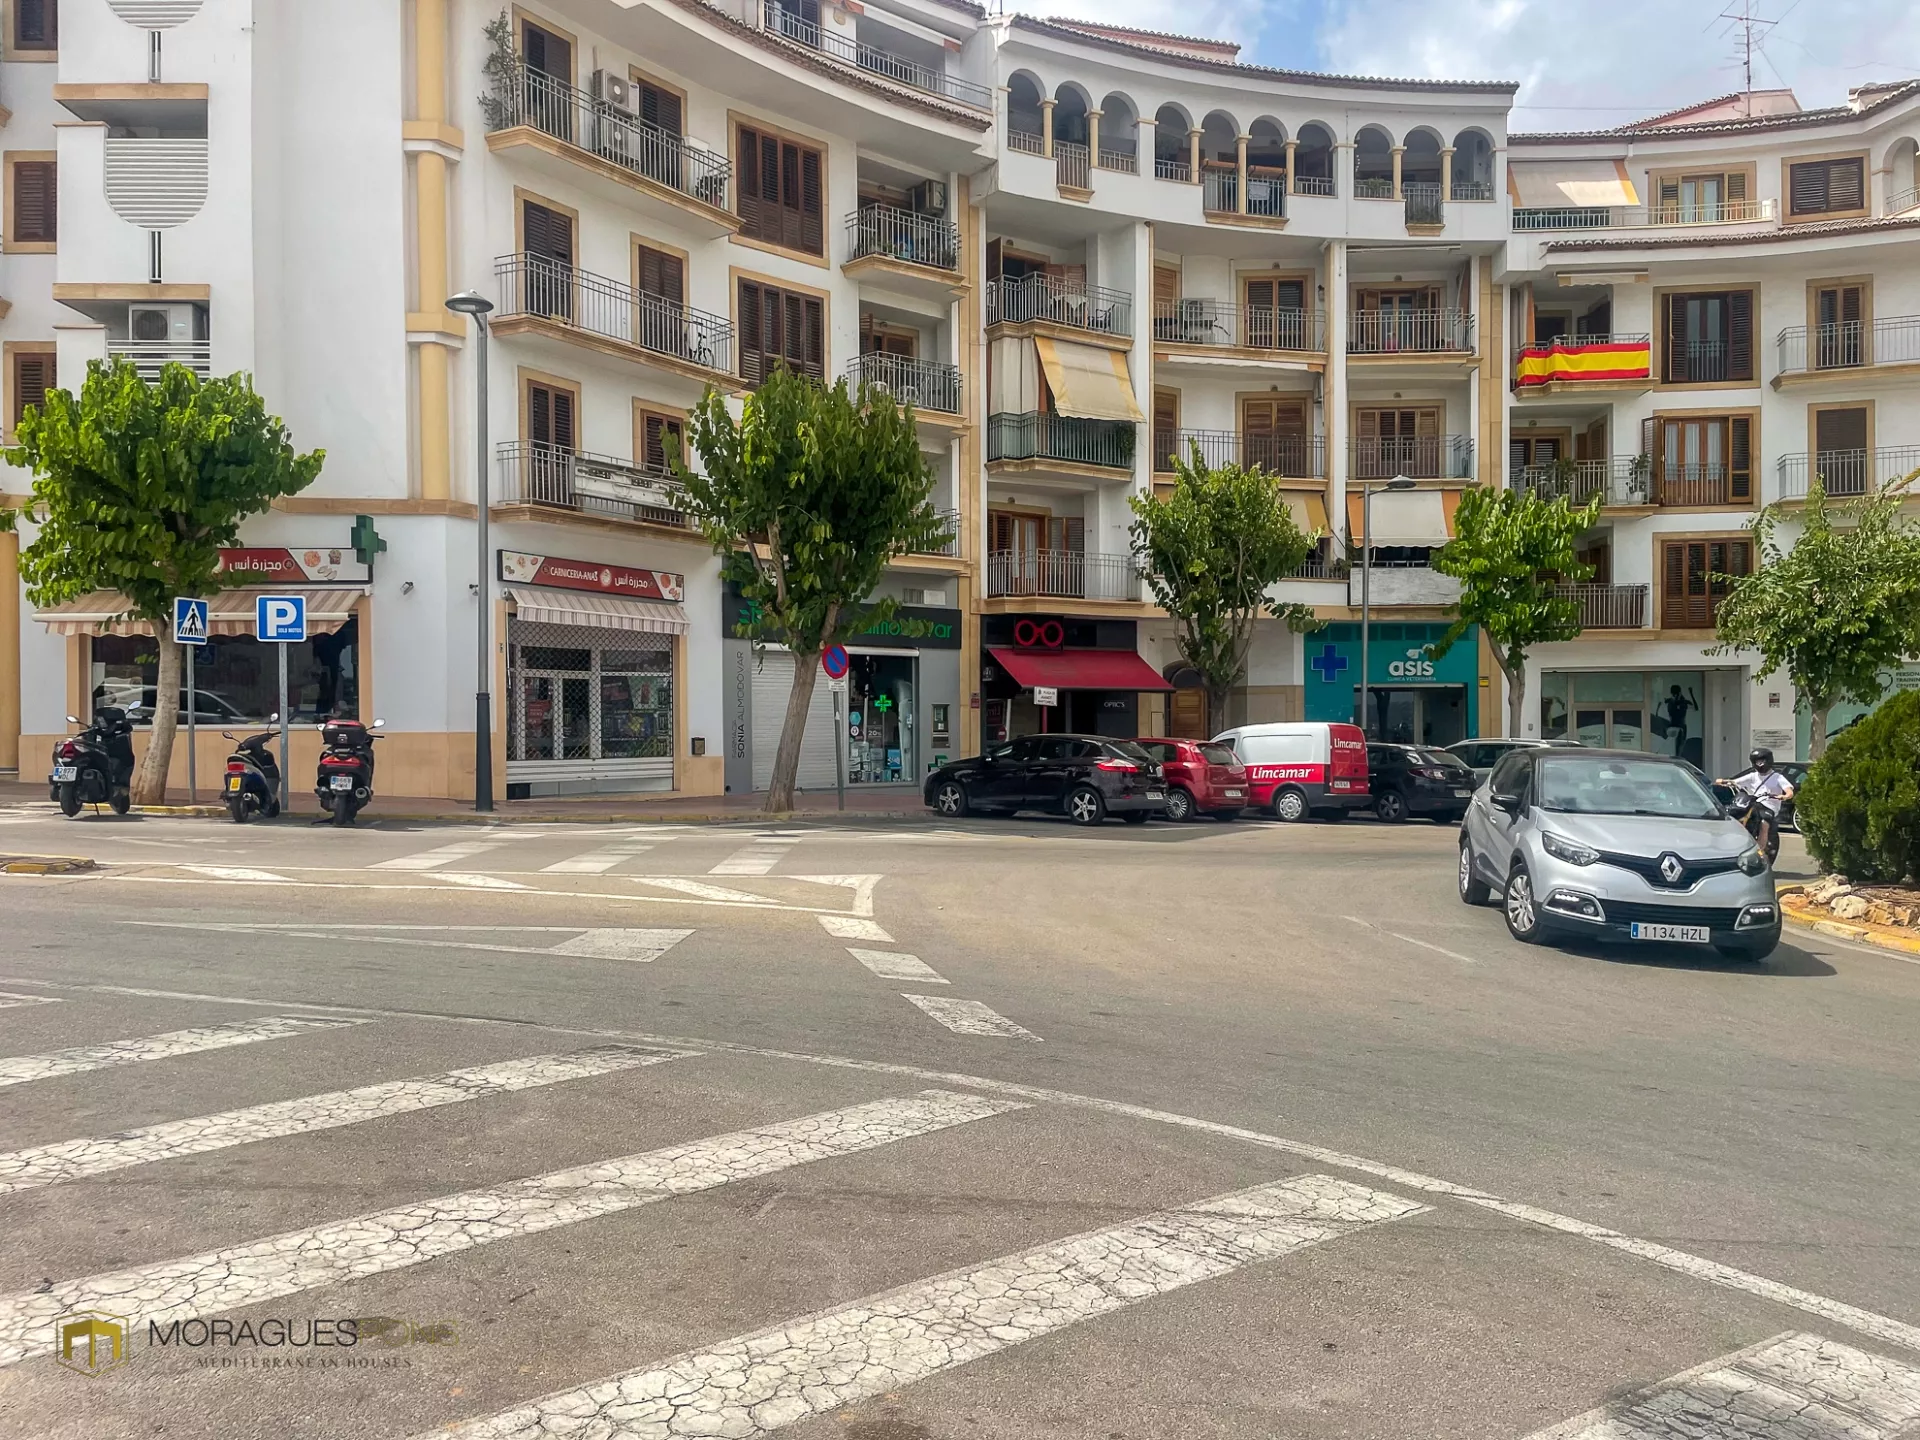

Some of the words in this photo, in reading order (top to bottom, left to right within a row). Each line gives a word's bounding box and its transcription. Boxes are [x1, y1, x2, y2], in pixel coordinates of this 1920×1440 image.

[266, 600, 298, 637] P
[1388, 660, 1434, 676] asis
[737, 651, 745, 721] ALMODOVAR
[1334, 738, 1363, 749] Limcamar
[1252, 767, 1311, 779] Limcamar
[1643, 926, 1676, 939] 1134
[1681, 928, 1706, 940] HZL
